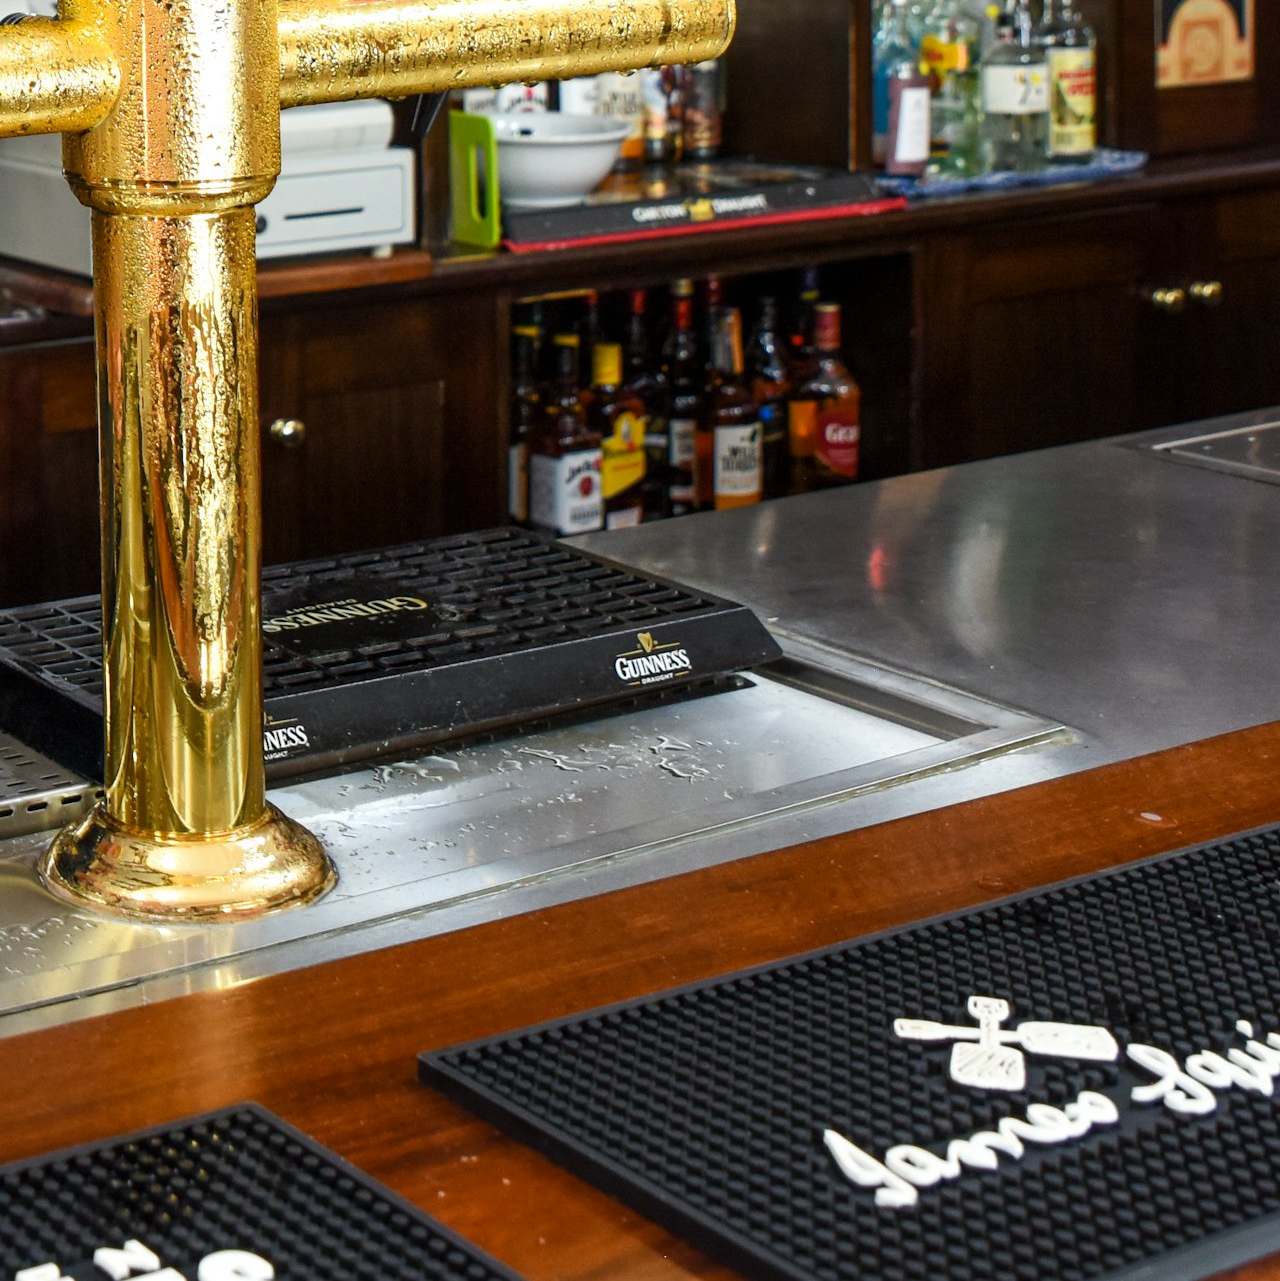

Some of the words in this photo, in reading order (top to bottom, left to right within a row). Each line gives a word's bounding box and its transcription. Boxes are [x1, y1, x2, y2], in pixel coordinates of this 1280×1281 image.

[286, 598, 358, 614] DRAUGHT
[615, 649, 691, 680] GUINNESS
[641, 672, 674, 684] DRAUGHT
[264, 725, 308, 752] NESS
[265, 751, 289, 760] UGHT
[822, 1089, 1119, 1209] James
